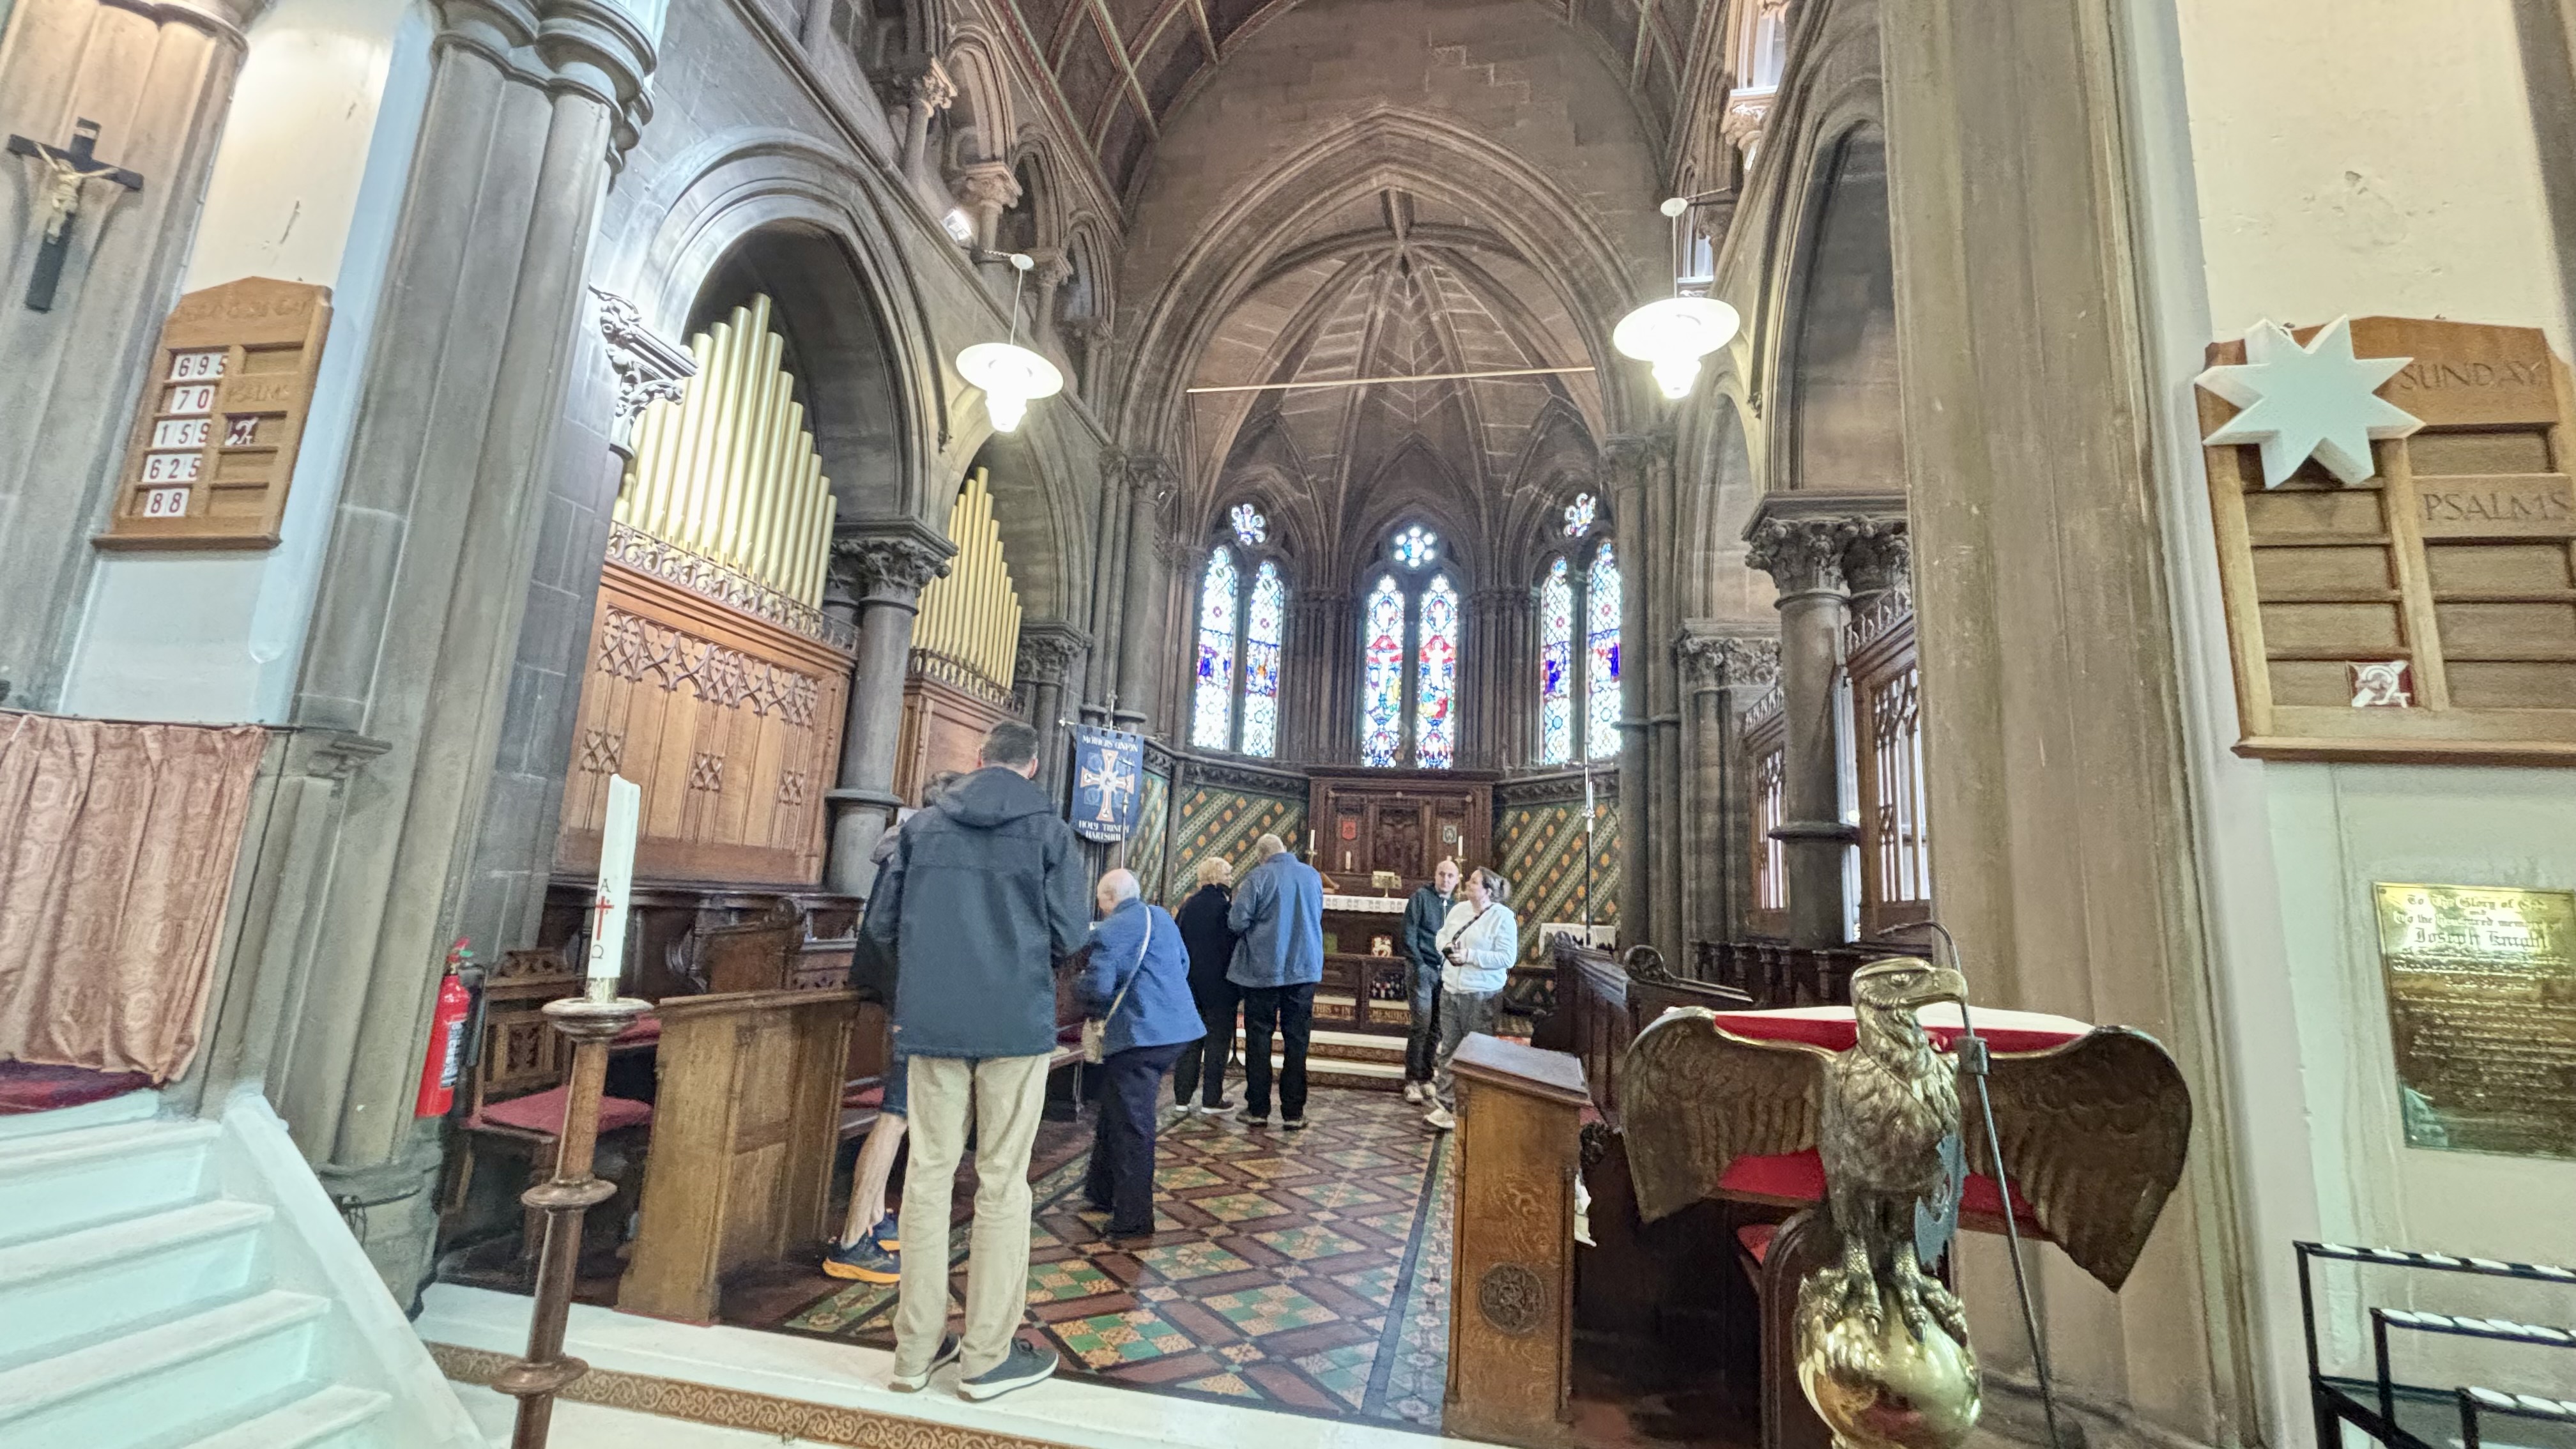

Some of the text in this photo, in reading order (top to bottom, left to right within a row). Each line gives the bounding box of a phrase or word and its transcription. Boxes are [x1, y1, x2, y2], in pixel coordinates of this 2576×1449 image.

[178, 355, 228, 378] 695
[2400, 360, 2543, 391] SUNDAY
[177, 388, 210, 410] 70
[161, 422, 211, 445] 159
[149, 457, 201, 479] 625
[150, 492, 183, 514] 88
[2423, 493, 2572, 521] PSALMS
[1078, 820, 1130, 833] HOLY TRINIY
[2501, 898, 2514, 908] of
[2414, 927, 2480, 949] Joseph
